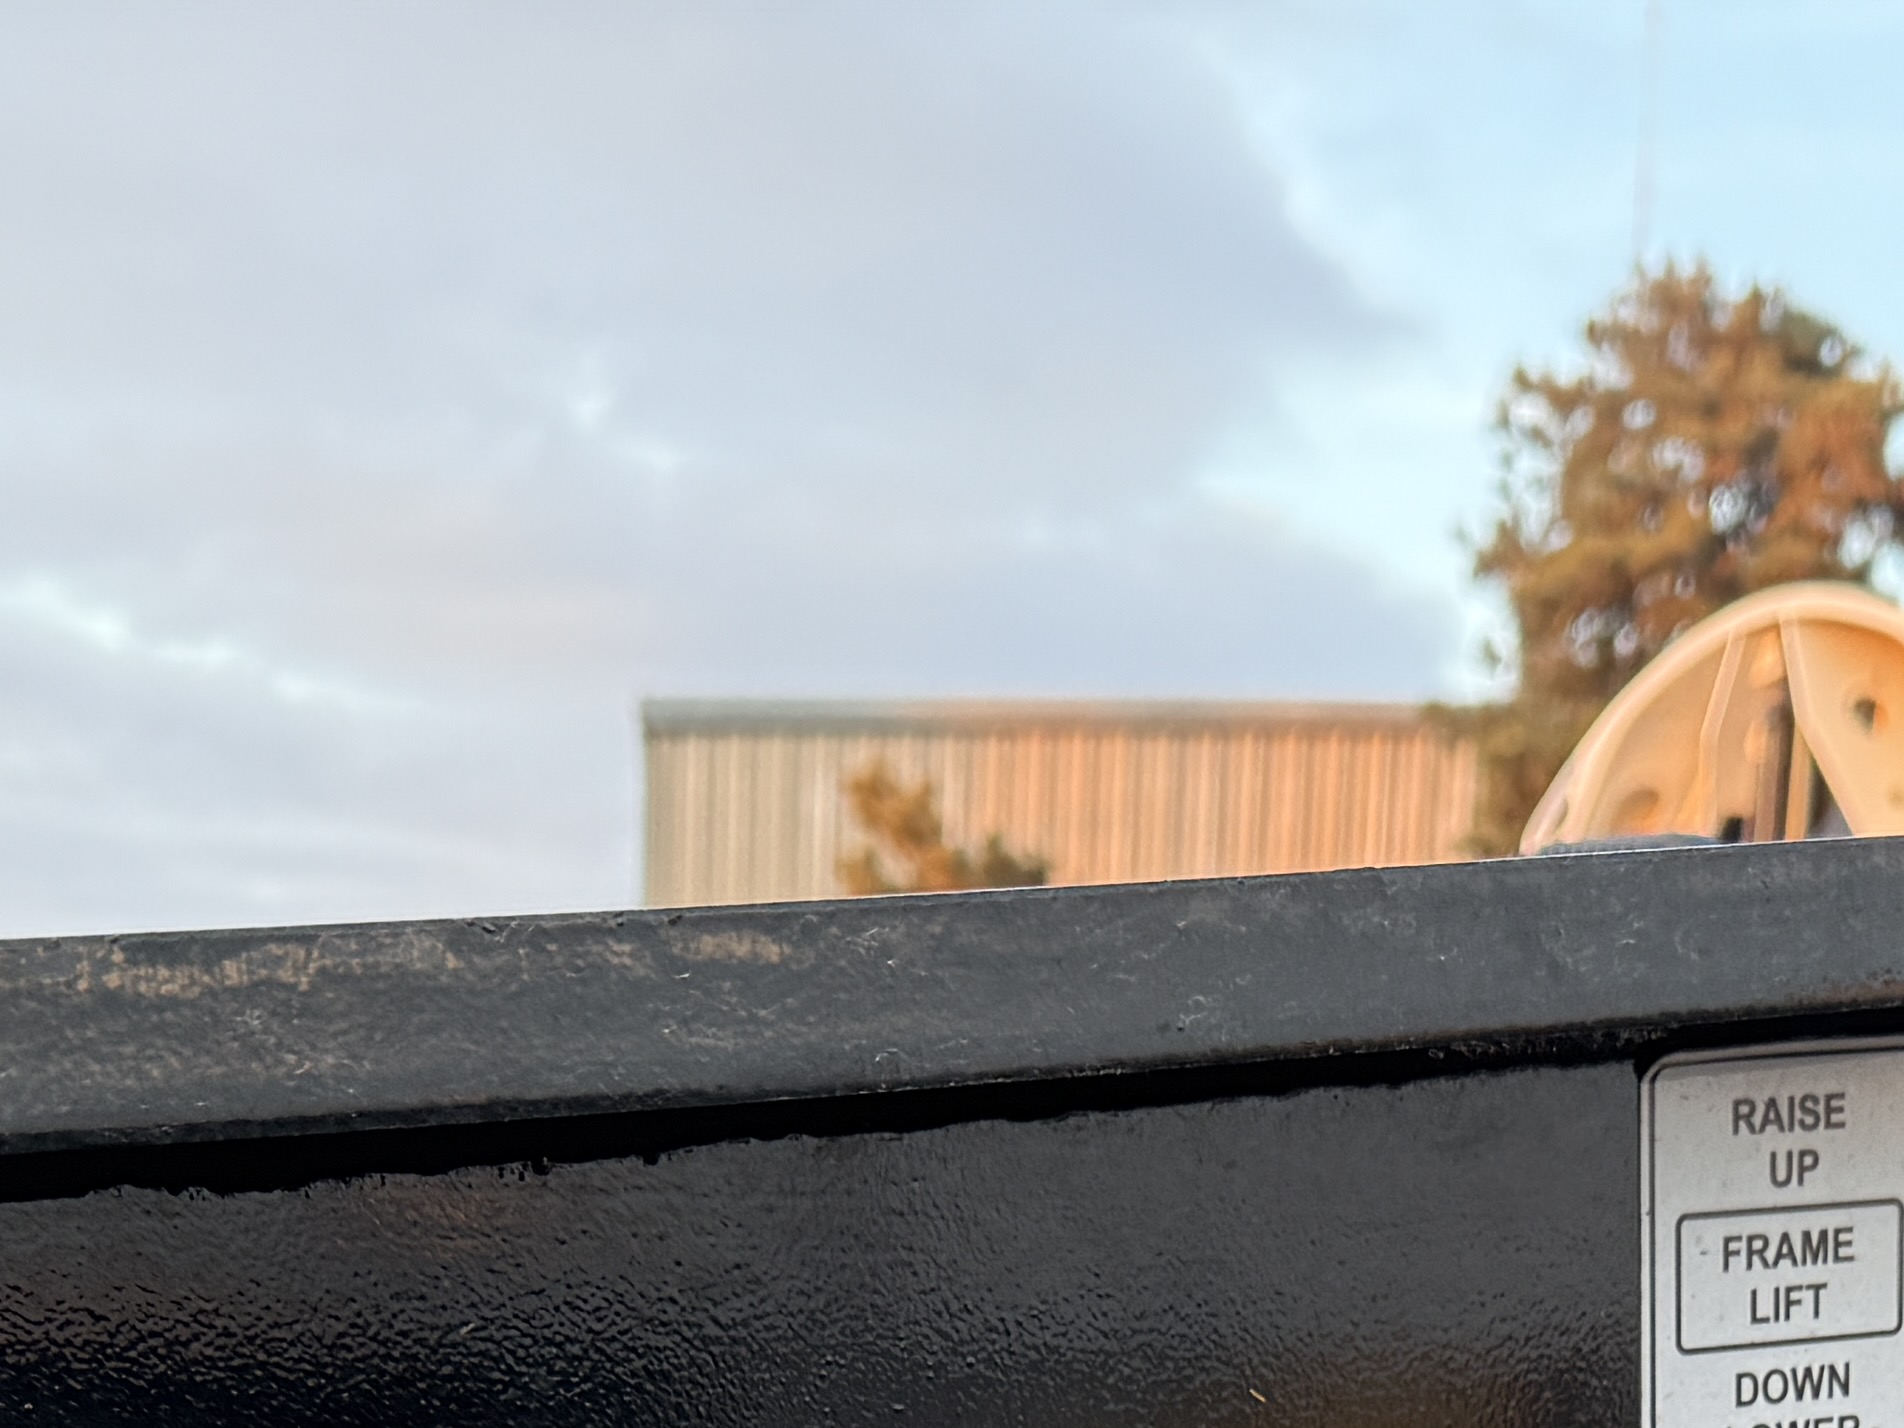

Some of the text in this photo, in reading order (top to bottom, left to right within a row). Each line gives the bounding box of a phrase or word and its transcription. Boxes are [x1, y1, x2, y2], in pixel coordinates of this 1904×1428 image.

[1731, 1092, 1847, 1136] RAISE
[1769, 1150, 1820, 1188] UP
[1721, 1227, 1855, 1273] FRAME
[1749, 1284, 1828, 1325] LIFT
[1735, 1362, 1851, 1409] DOWN
